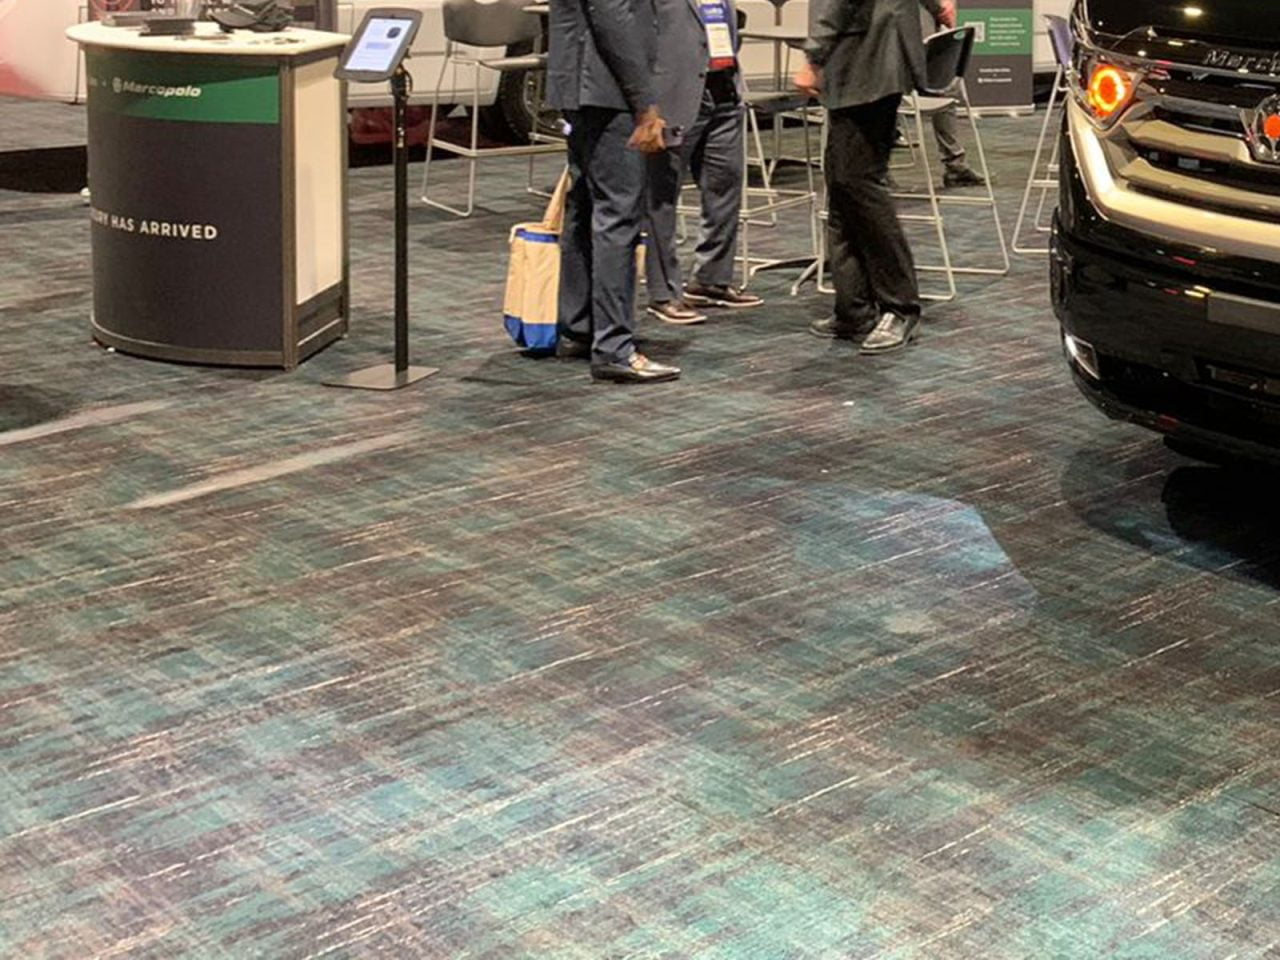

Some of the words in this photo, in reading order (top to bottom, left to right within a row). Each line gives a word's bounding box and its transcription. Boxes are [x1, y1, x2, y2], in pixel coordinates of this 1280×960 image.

[122, 80, 202, 97] Marcopolo
[110, 215, 135, 232] HAS
[139, 220, 217, 239] ARRIVED
